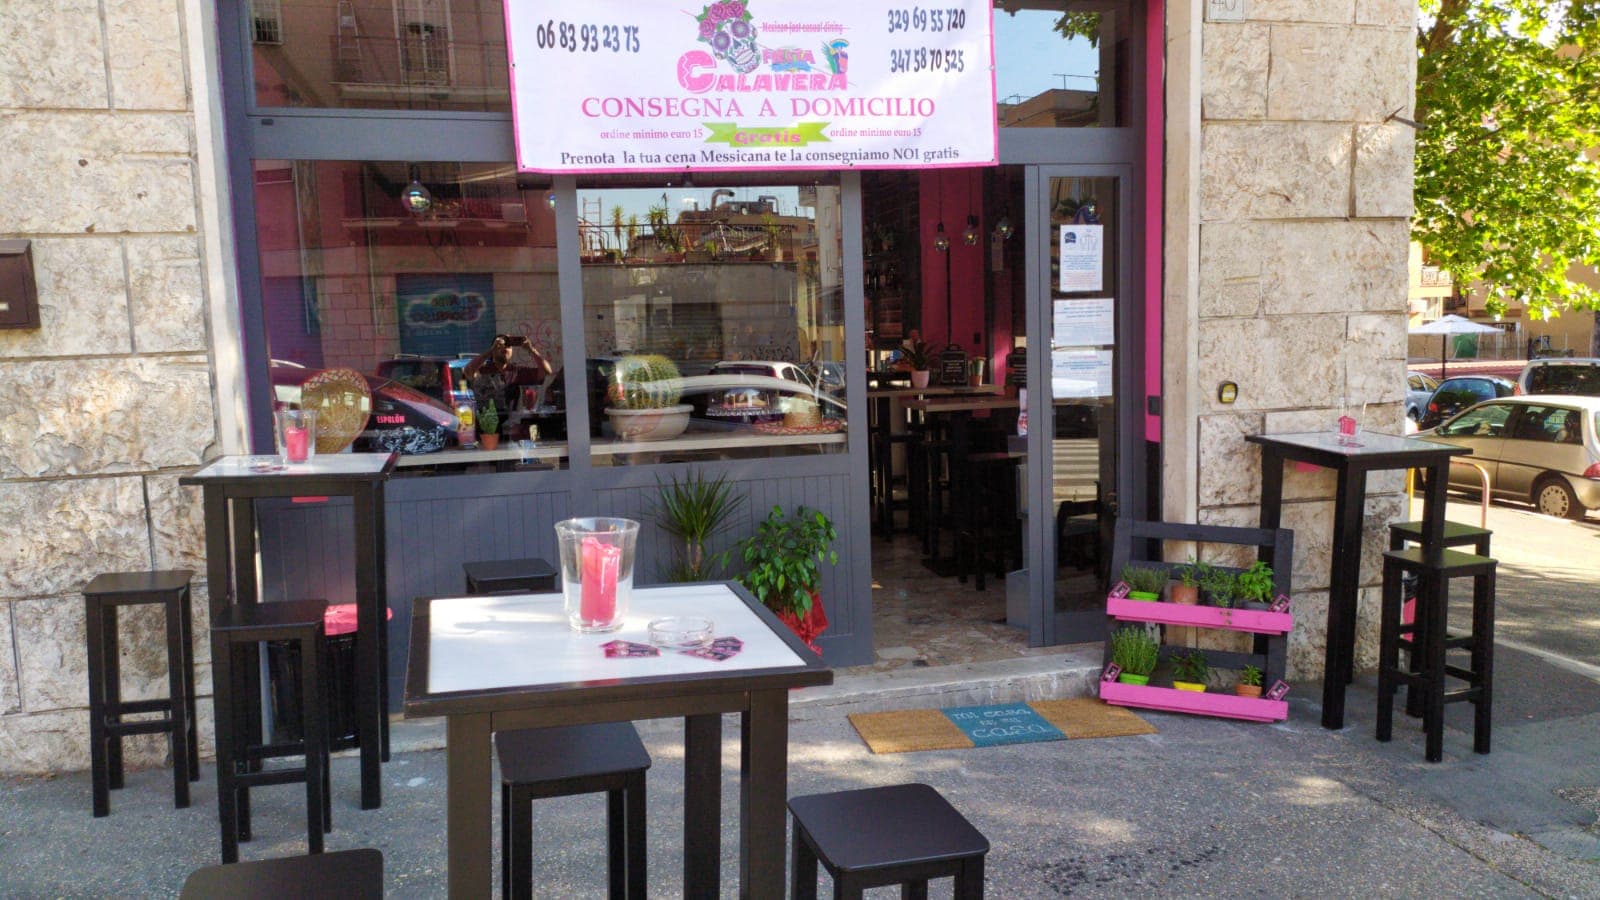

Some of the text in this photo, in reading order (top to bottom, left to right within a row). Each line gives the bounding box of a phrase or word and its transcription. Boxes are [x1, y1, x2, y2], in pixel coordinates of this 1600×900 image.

[888, 6, 966, 33] 329 69 55 720
[537, 19, 640, 53] 06 83 93 23 75
[890, 46, 964, 73] 347 58 70 525
[676, 49, 848, 95] CALAVERA
[581, 97, 936, 118] CONSEGNA A DOMICILIO
[600, 128, 704, 139] ordine minimo euro 15
[734, 130, 801, 145] Gratis
[830, 127, 922, 137] ordine minimo euro 15
[561, 146, 959, 165] Prenota la tua cena Messicana te la consegniamo NOI gratis
